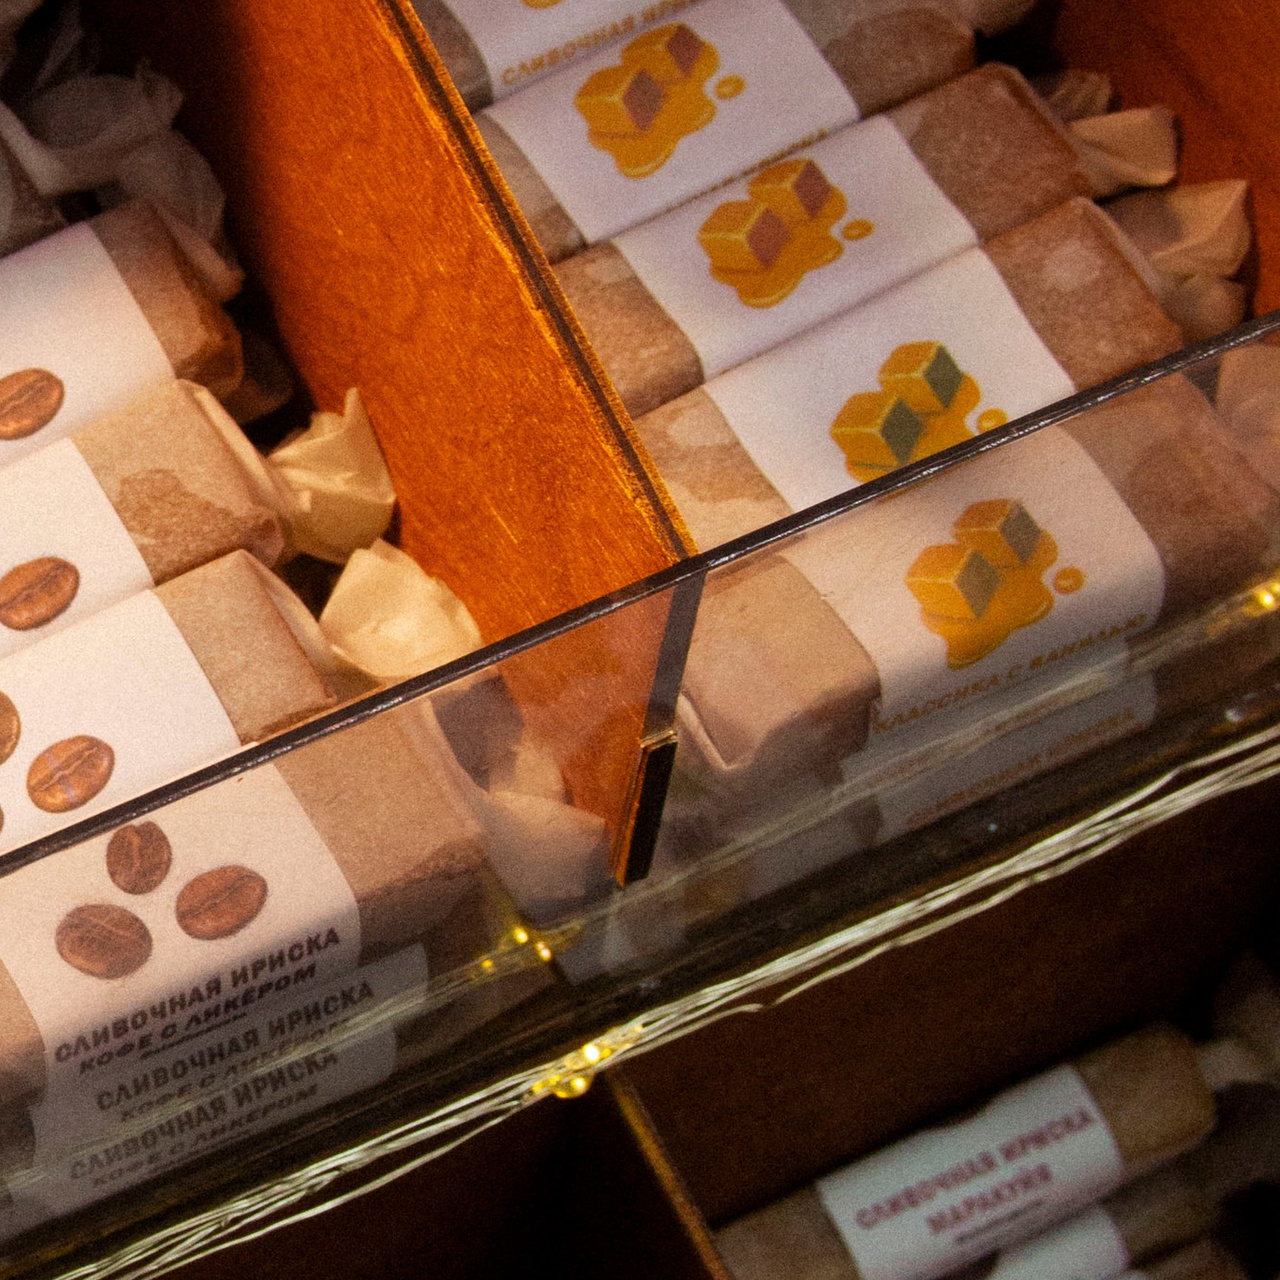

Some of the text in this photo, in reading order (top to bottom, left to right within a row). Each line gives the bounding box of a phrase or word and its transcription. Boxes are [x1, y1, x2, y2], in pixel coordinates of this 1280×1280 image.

[55, 978, 221, 1063] СЛИВОЧНАЯ
[231, 927, 341, 988] ИРИСКА
[78, 1032, 153, 1074] КОФЕ
[95, 1027, 260, 1112] СЛИВОЧНАЯ
[266, 980, 375, 1040] ИРИСКА
